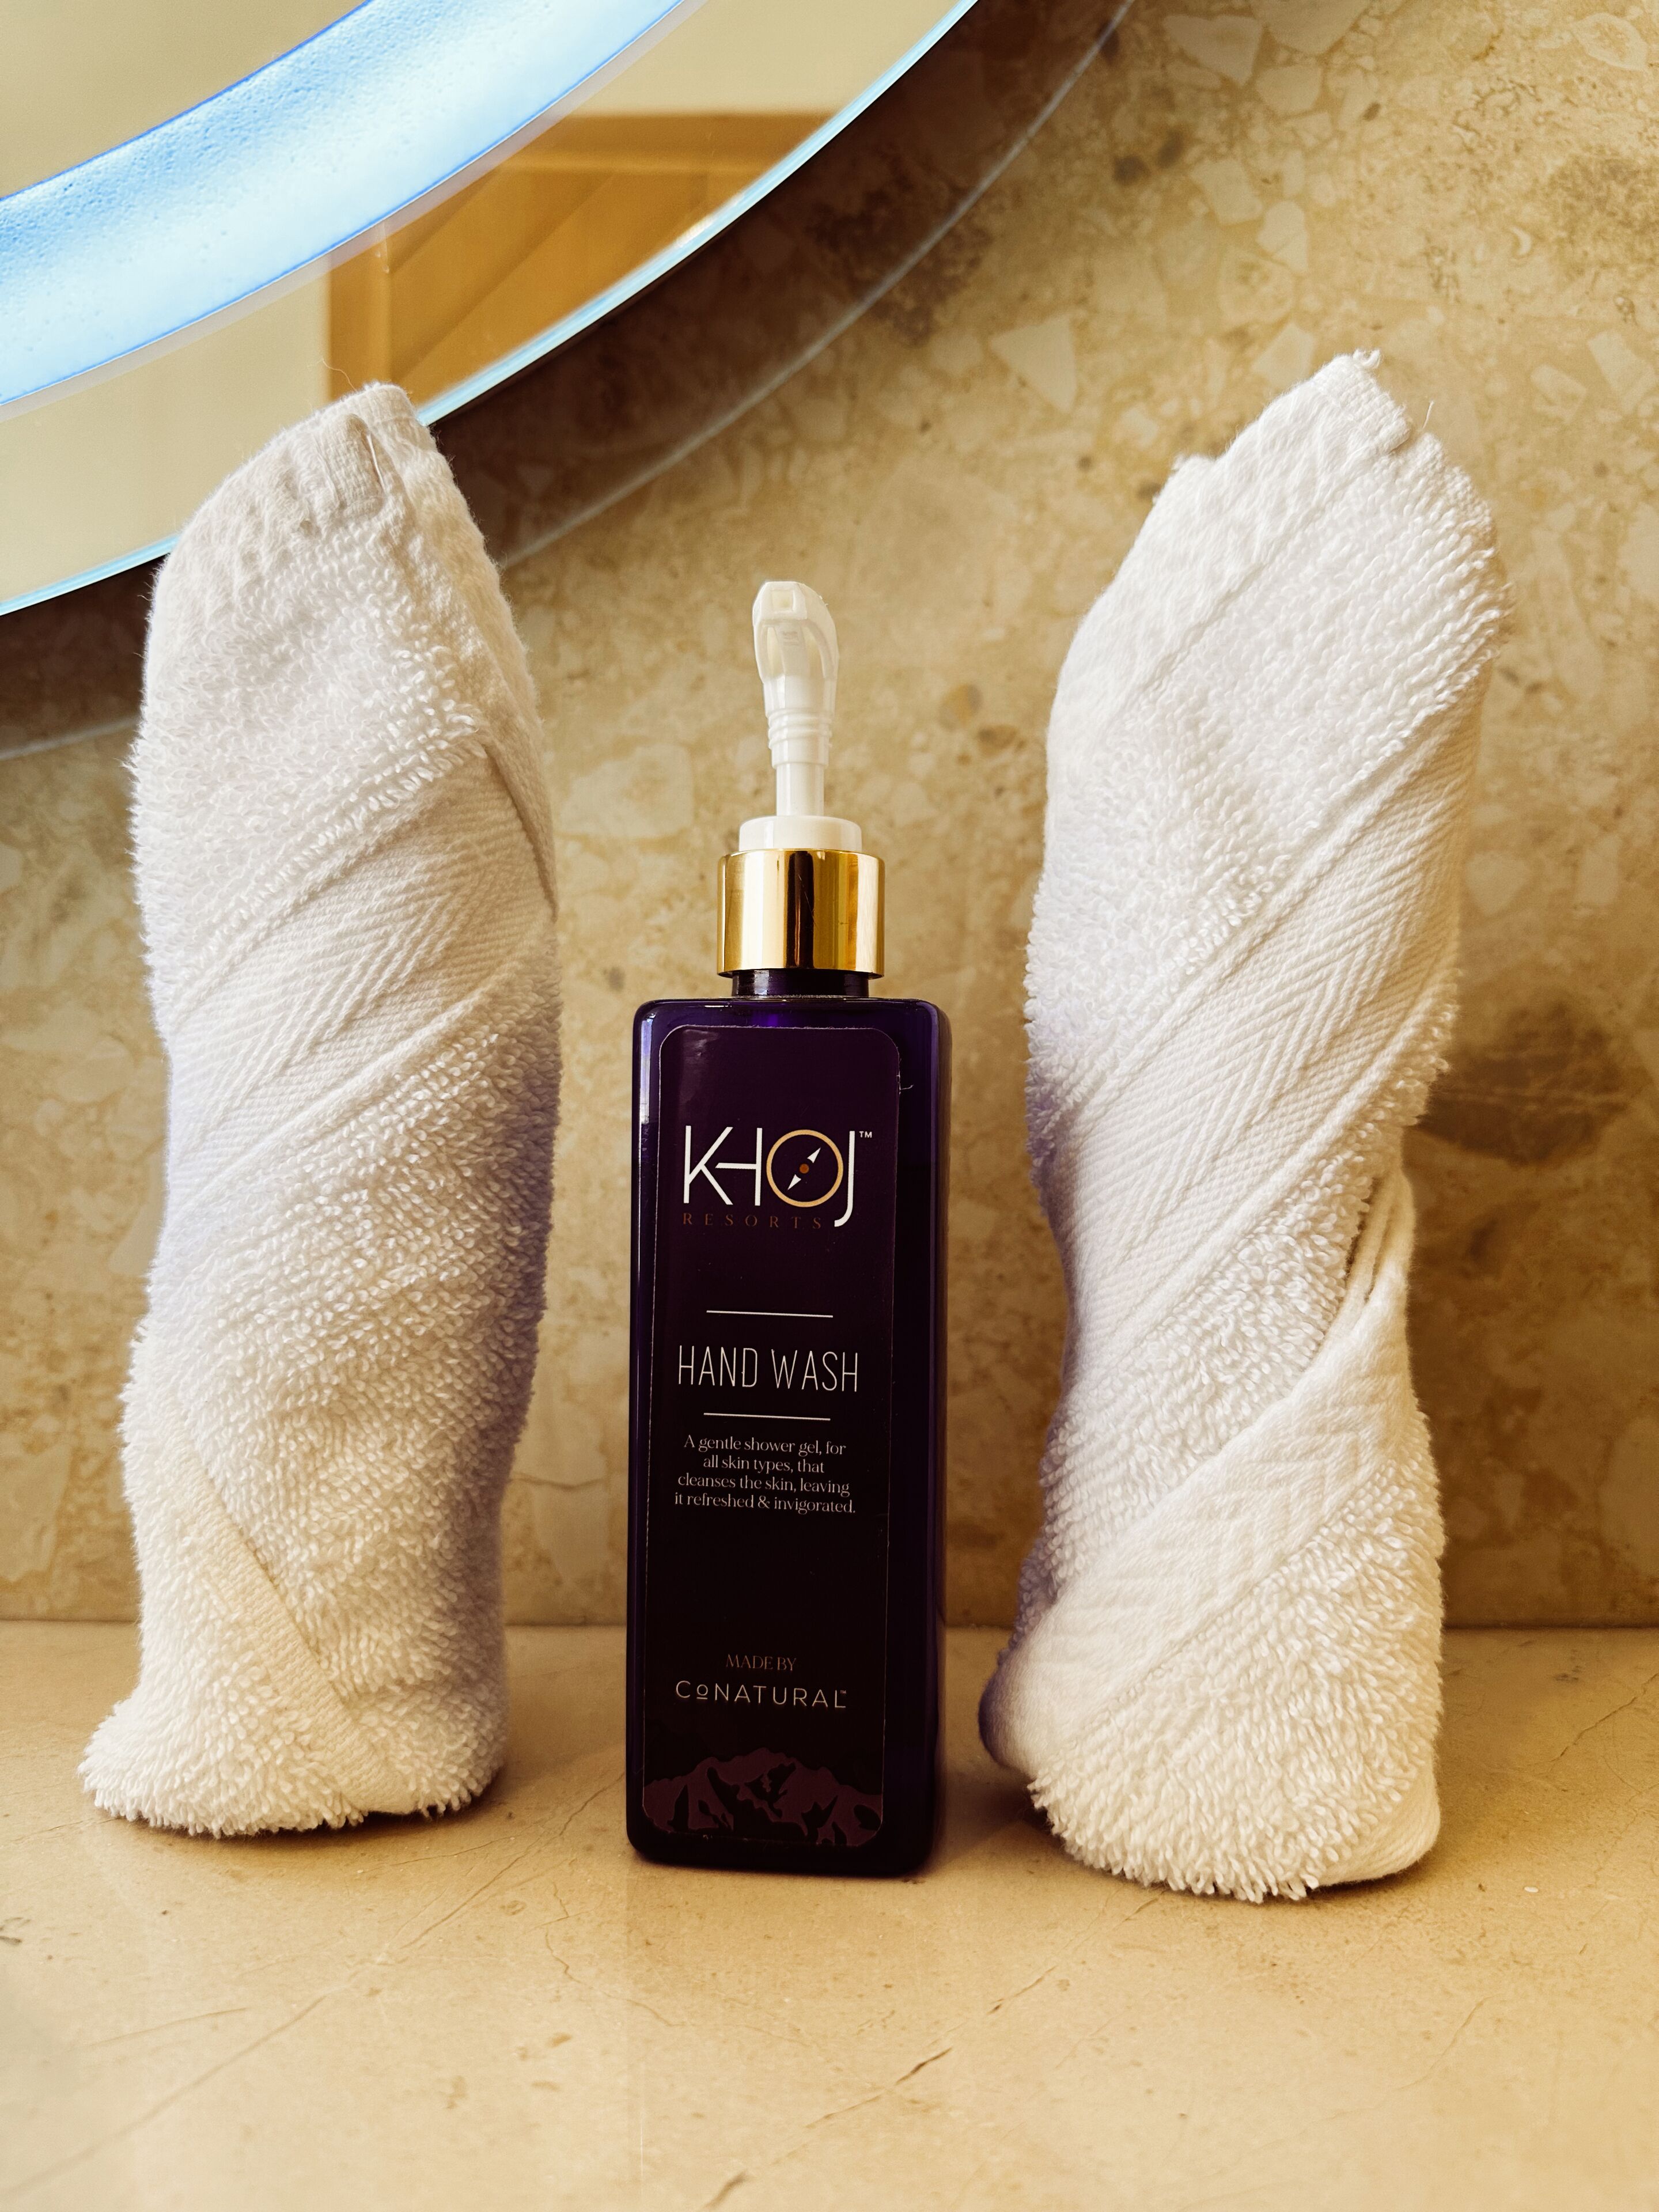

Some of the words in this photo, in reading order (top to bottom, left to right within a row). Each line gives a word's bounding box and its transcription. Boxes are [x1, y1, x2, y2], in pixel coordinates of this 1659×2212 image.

[684, 1126, 855, 1227] KHOJ
[683, 1212, 821, 1229] RESORTS
[679, 1345, 757, 1388] HAND
[771, 1349, 858, 1392] WASH
[684, 1434, 695, 1449] A
[699, 1436, 741, 1453] gentle
[744, 1437, 795, 1453] shower
[798, 1441, 822, 1457] gel,
[825, 1441, 846, 1455] for
[703, 1456, 718, 1468] all
[721, 1456, 749, 1469] skin
[753, 1458, 794, 1474] types,
[797, 1459, 824, 1473] that
[677, 1473, 736, 1488] cleanses
[740, 1475, 762, 1489] the
[765, 1476, 796, 1493] skin,
[800, 1478, 850, 1498] leaving
[675, 1493, 684, 1505] it
[687, 1493, 753, 1509] refreshed
[757, 1496, 770, 1509] &
[774, 1497, 856, 1515] invigorated.
[726, 1654, 773, 1670] MADE
[777, 1657, 796, 1672] BY
